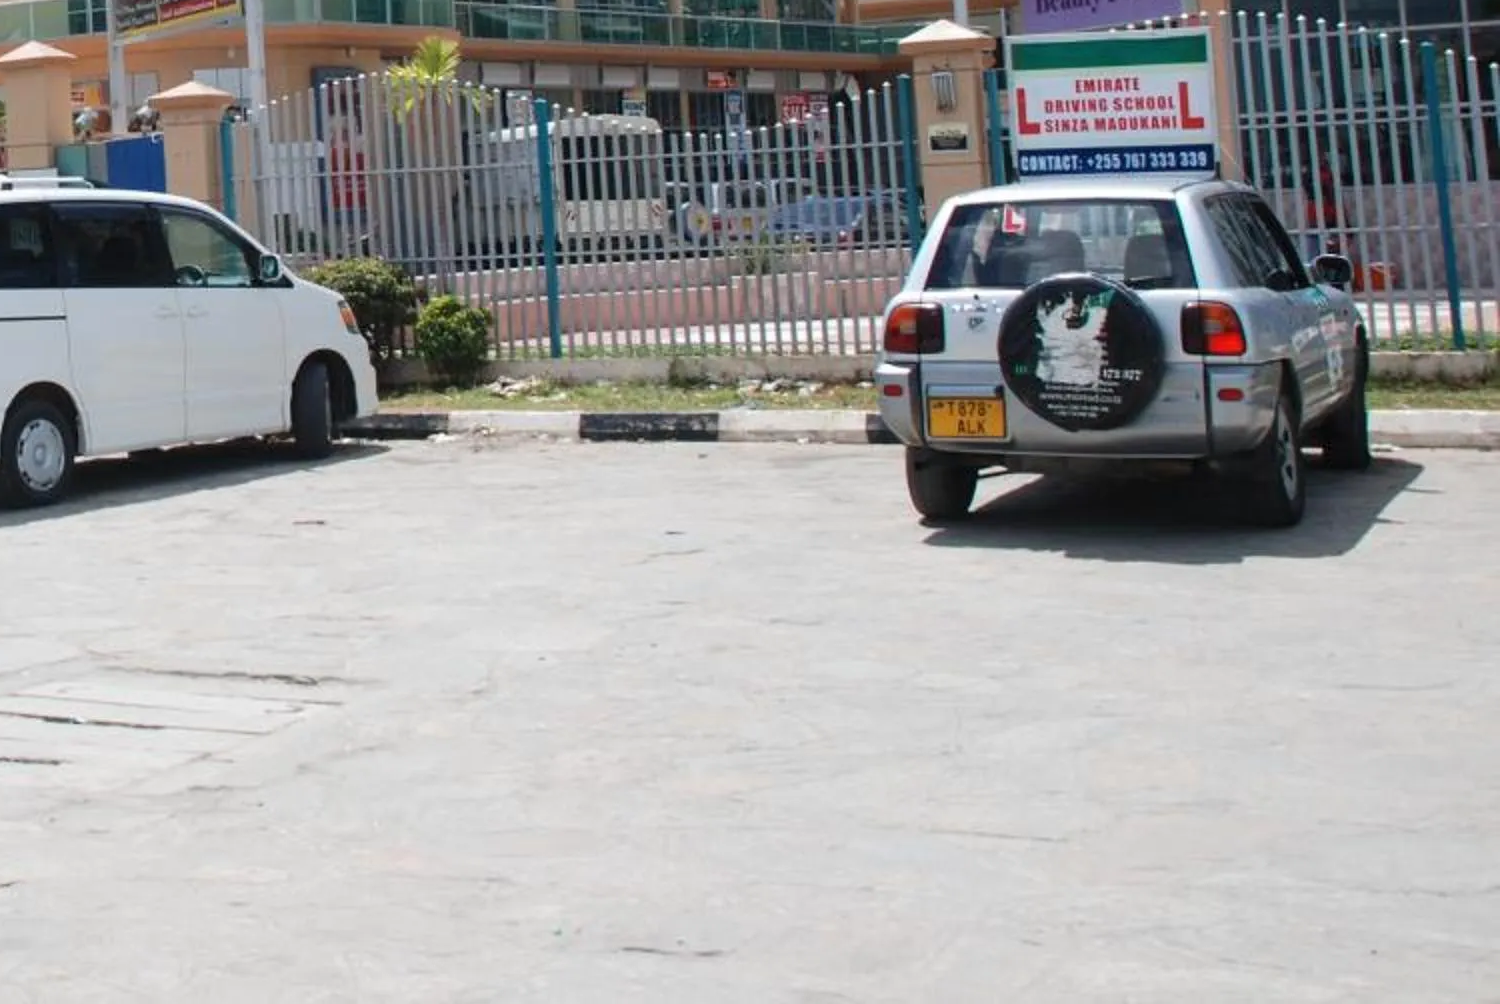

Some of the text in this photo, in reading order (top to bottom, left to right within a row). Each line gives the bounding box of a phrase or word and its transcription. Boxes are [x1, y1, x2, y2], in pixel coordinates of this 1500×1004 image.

[1075, 77, 1141, 93] EMIRATE
[1016, 88, 1041, 134] L
[1044, 96, 1175, 114] DRIVING SCHOOL
[1178, 81, 1205, 129] L
[1045, 116, 1177, 133] SINZA MADUKANI
[1020, 155, 1083, 171] CONTACT:
[1087, 153, 1121, 169] +255
[958, 419, 985, 434] ALK
